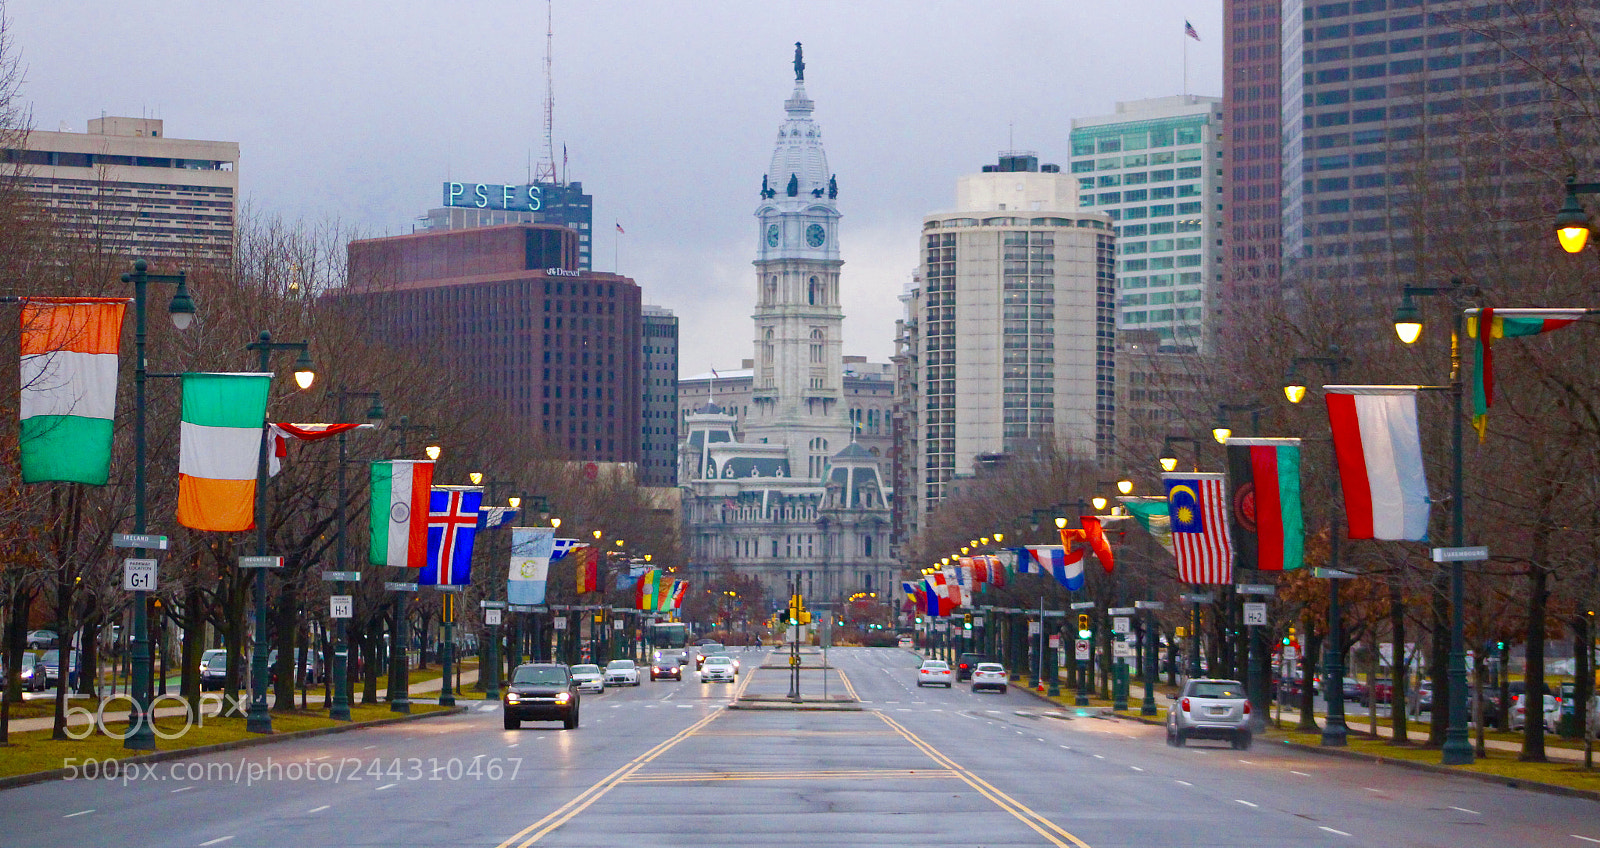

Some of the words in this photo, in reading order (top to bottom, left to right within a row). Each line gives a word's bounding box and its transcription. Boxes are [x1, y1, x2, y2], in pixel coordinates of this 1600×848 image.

[131, 573, 148, 588] G-1
[335, 605, 348, 616] H-1
[1247, 612, 1262, 623] H-2
